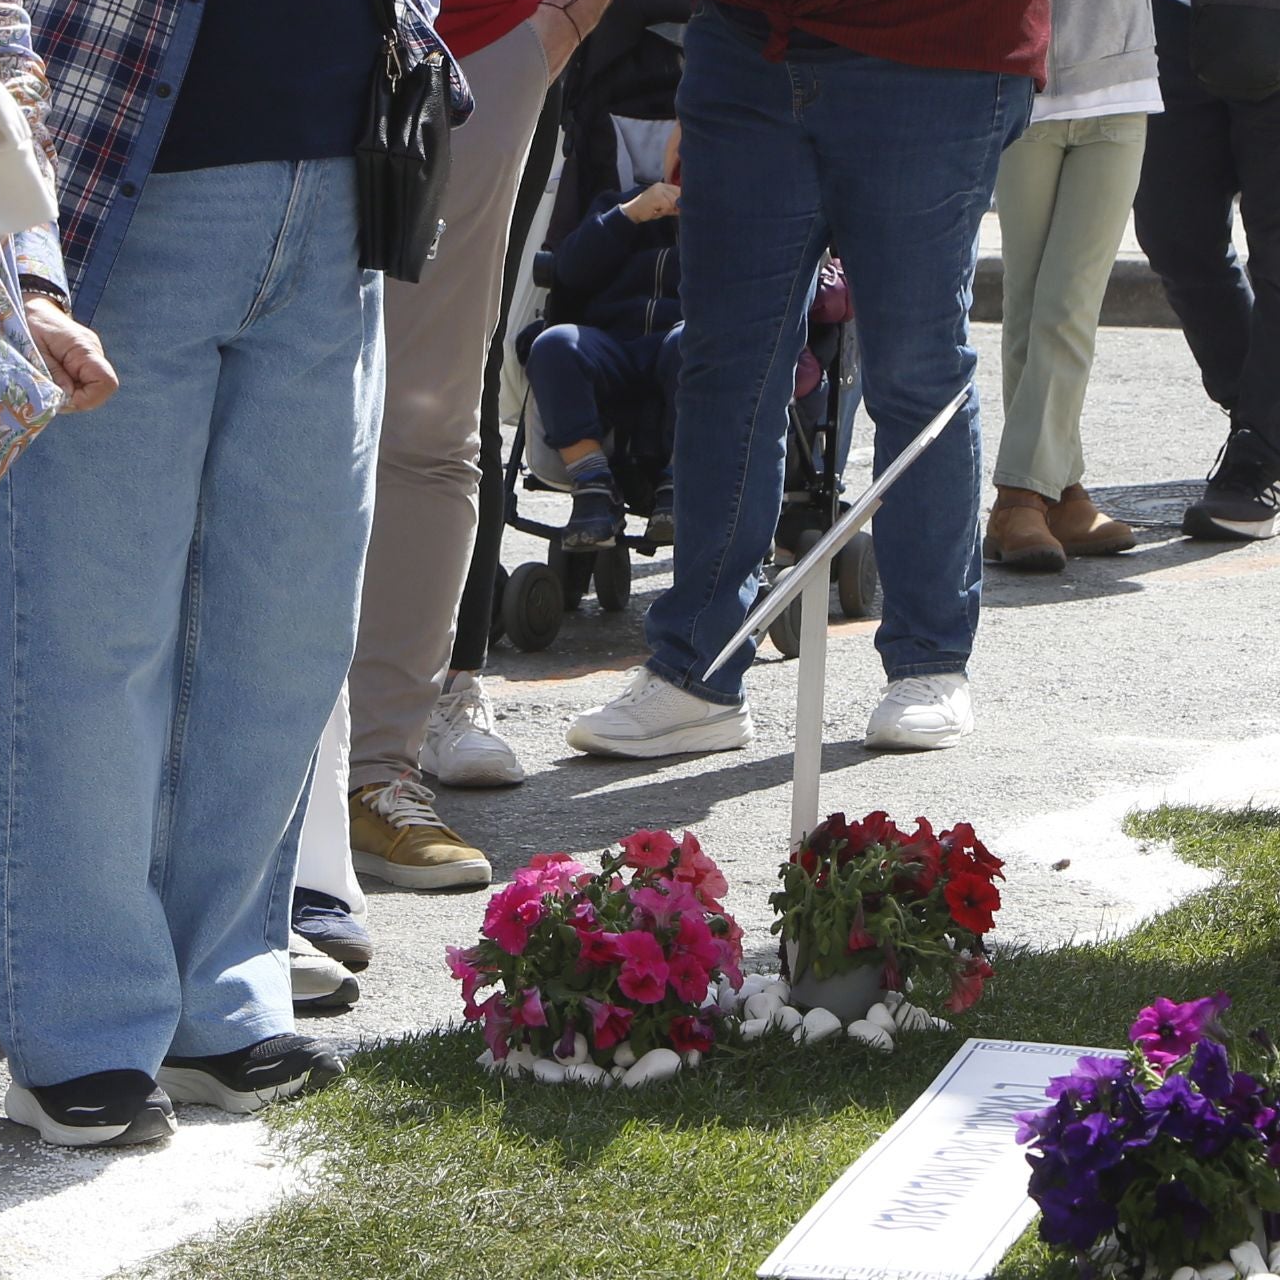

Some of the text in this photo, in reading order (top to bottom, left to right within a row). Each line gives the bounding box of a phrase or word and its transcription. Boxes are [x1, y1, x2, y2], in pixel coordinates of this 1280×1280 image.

[929, 1138, 1010, 1165] DELS
[898, 1163, 990, 1198] NOUS
[867, 1199, 958, 1232] DEUS
